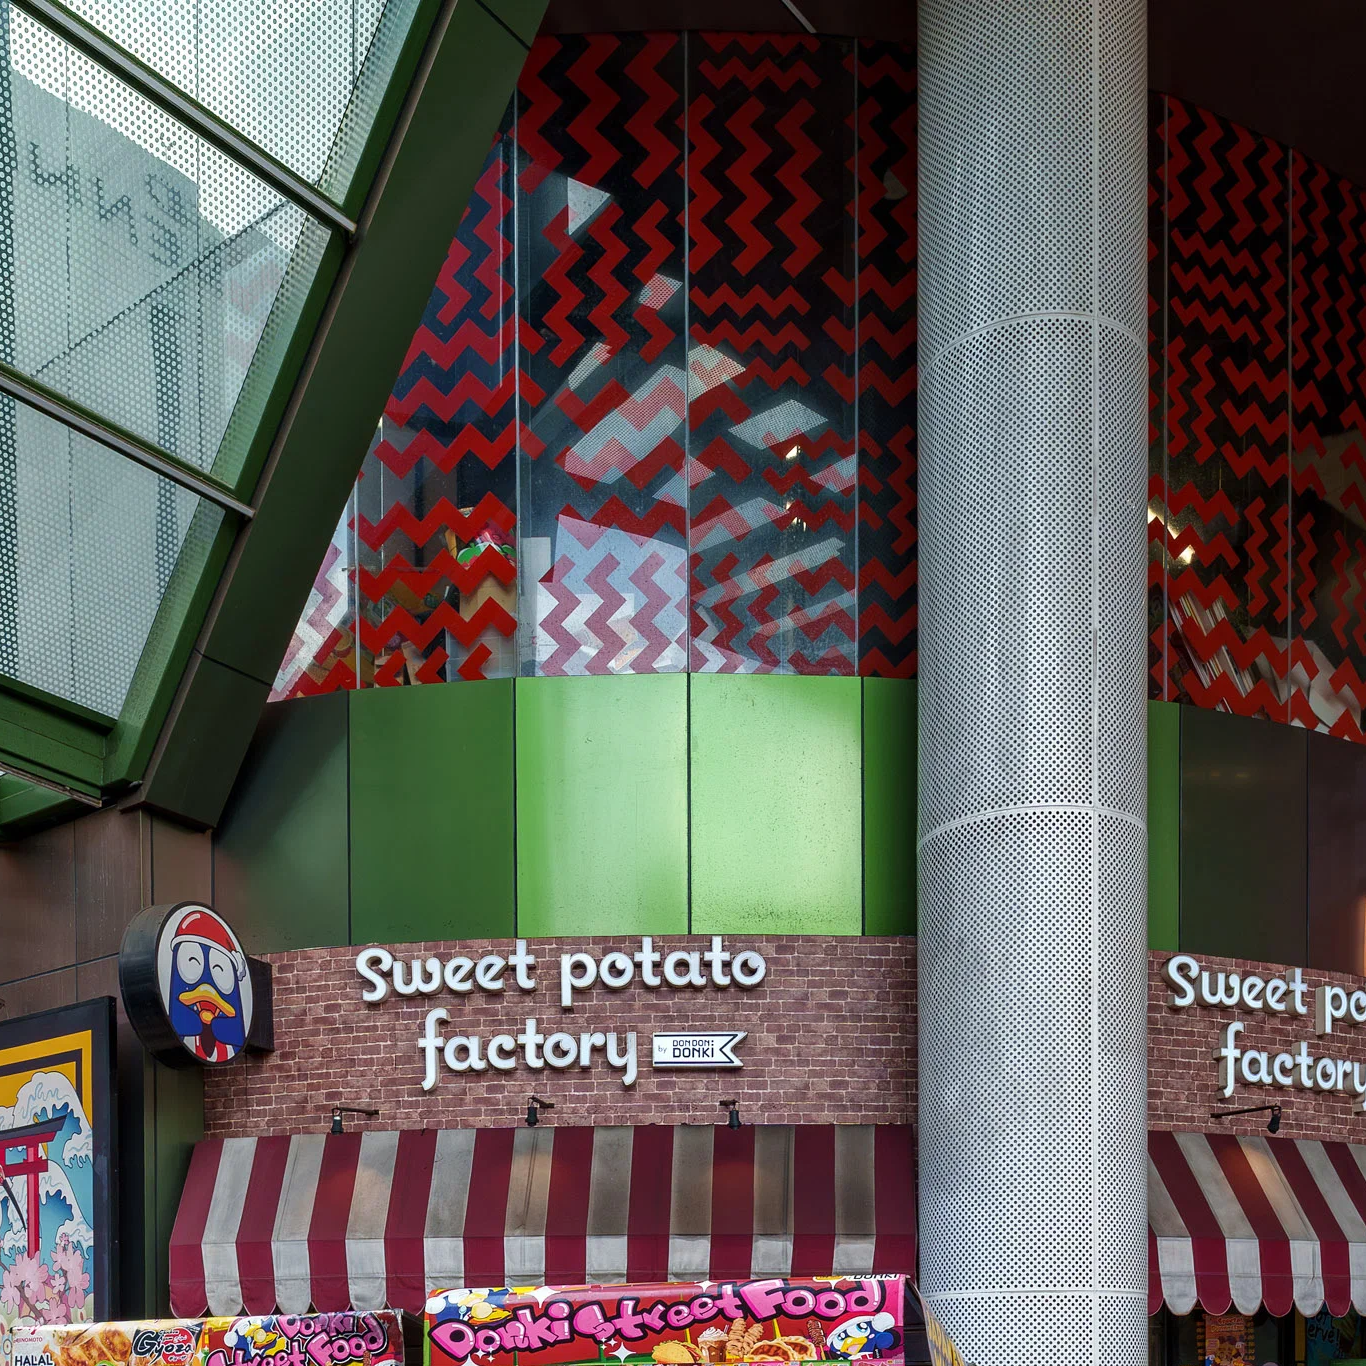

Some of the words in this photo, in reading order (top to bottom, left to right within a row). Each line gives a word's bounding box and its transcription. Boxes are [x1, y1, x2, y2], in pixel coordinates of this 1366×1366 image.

[355, 938, 537, 1002] Sweet
[561, 935, 767, 1008] potato
[1164, 955, 1308, 1015] Sweet
[417, 1006, 638, 1092] factory
[671, 1047, 715, 1059] DONKI
[134, 1329, 193, 1366] Gyoza
[276, 1314, 355, 1340] Donki
[431, 1301, 572, 1360] Donki
[572, 1289, 743, 1343] Street
[739, 1278, 883, 1320] Food
